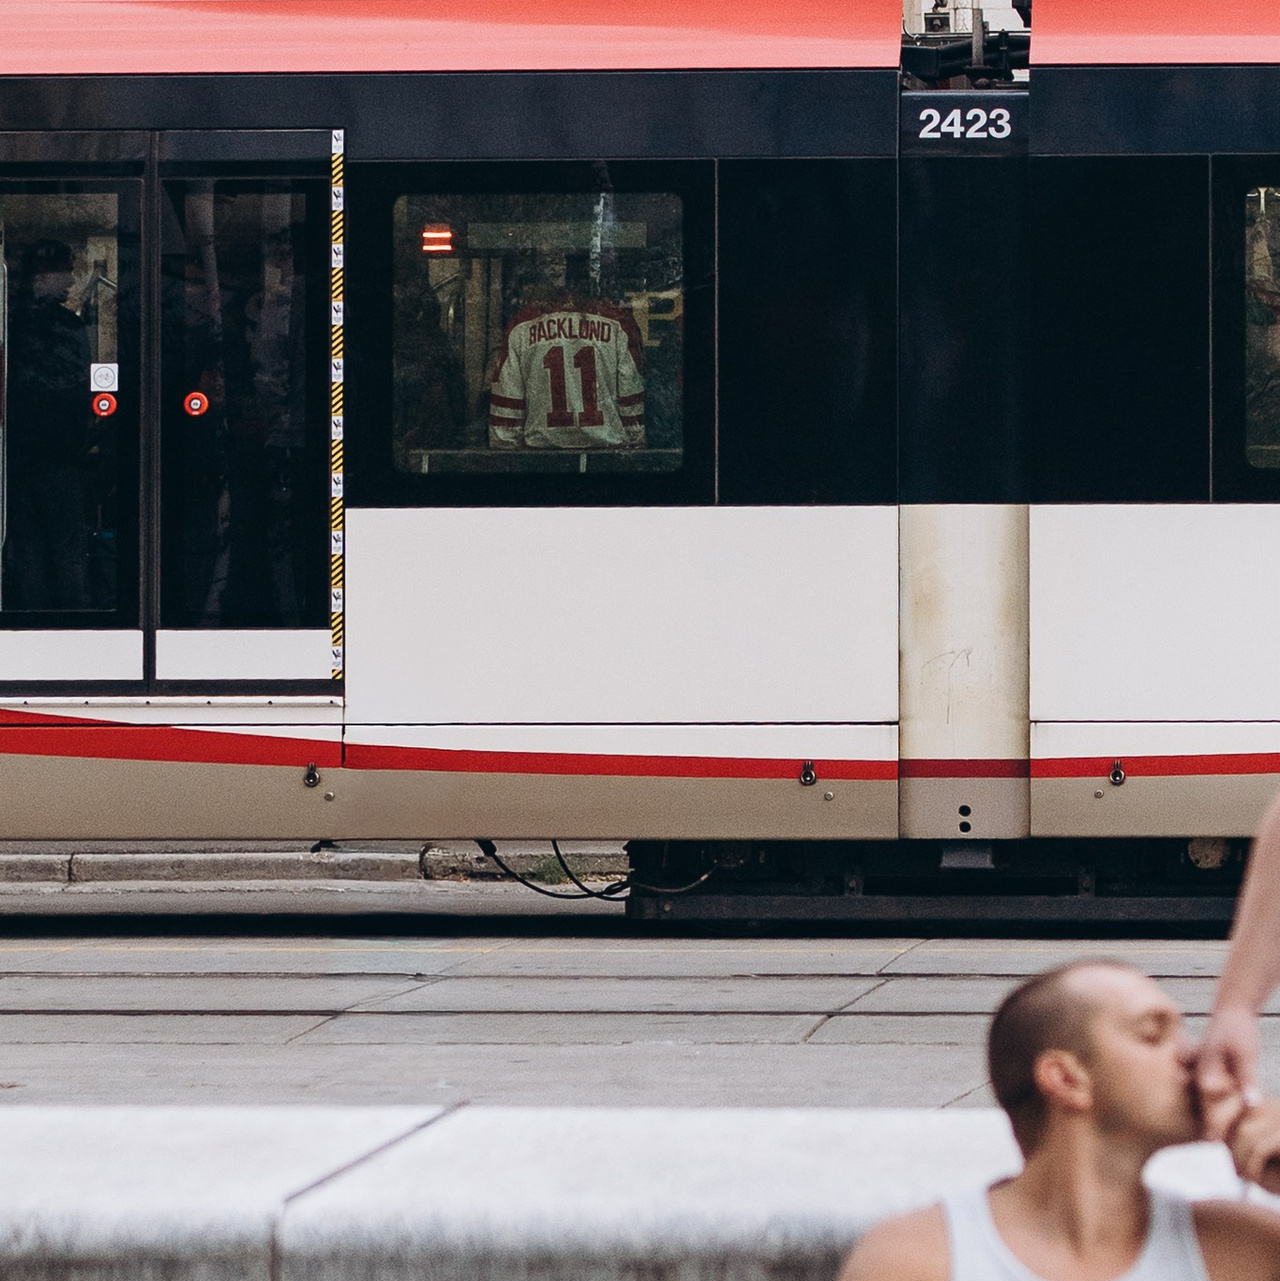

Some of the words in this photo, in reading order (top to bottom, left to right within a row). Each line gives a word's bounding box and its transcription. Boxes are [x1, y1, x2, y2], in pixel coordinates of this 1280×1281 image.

[918, 108, 1011, 139] 2423
[529, 317, 611, 346] BACKLUND
[544, 345, 604, 427] 11
